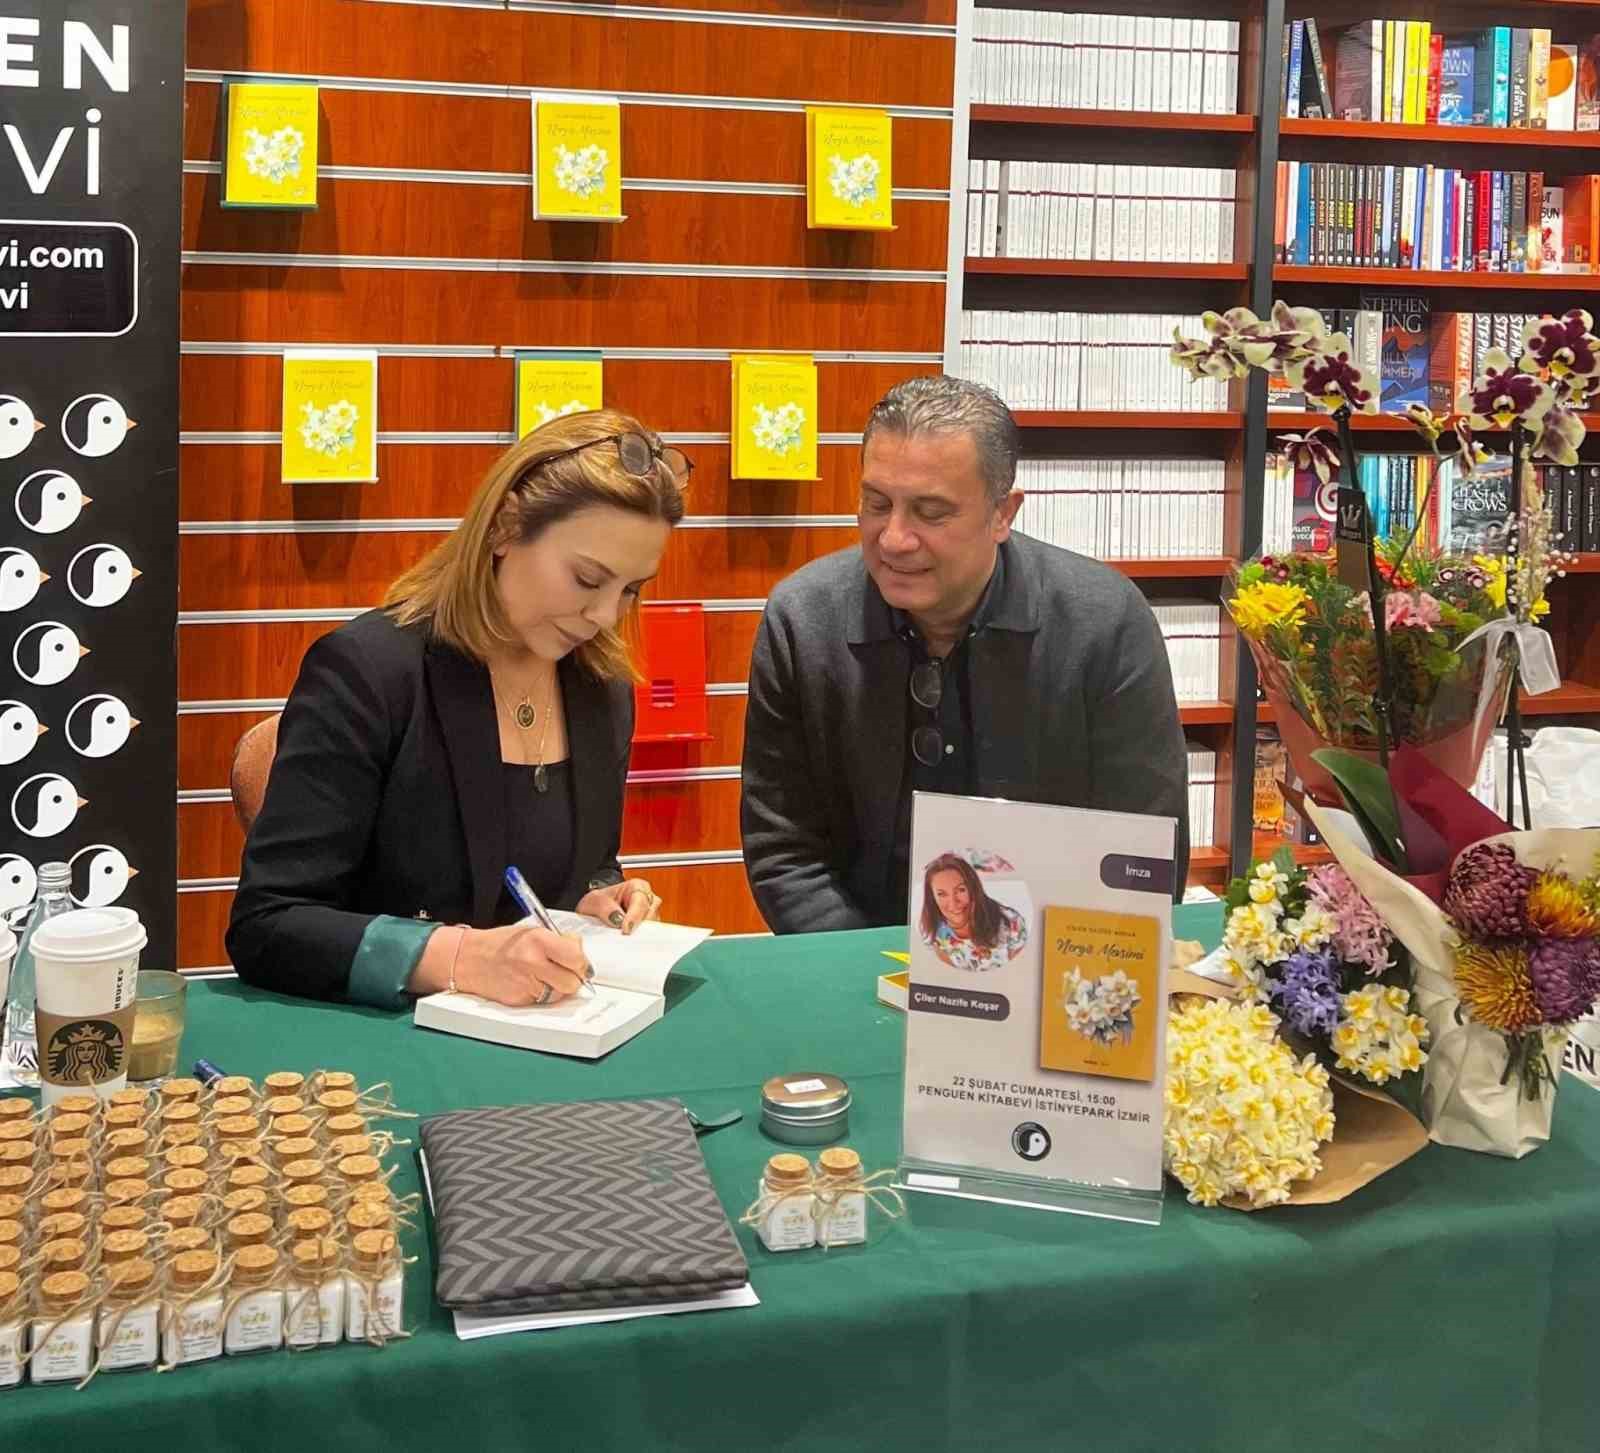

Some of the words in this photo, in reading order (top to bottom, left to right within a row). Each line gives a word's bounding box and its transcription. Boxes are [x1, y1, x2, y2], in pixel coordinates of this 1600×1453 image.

[0, 17, 130, 92] EN
[1443, 48, 1461, 57] AN
[1360, 297, 1430, 313] STEPHEN
[1385, 313, 1422, 333] ING
[1382, 351, 1409, 364] ILLY
[1453, 497, 1508, 512] CROWS
[952, 1075, 965, 1086] 22
[968, 1078, 1008, 1092] ŞUBAT
[1087, 1093, 1116, 1106] 15:00
[918, 1084, 975, 1101] PENGUEN
[978, 1091, 1032, 1109] KİTABEVİ
[1035, 1099, 1114, 1119] İSTİNYEPARK
[1117, 1108, 1151, 1123] İZMİR
